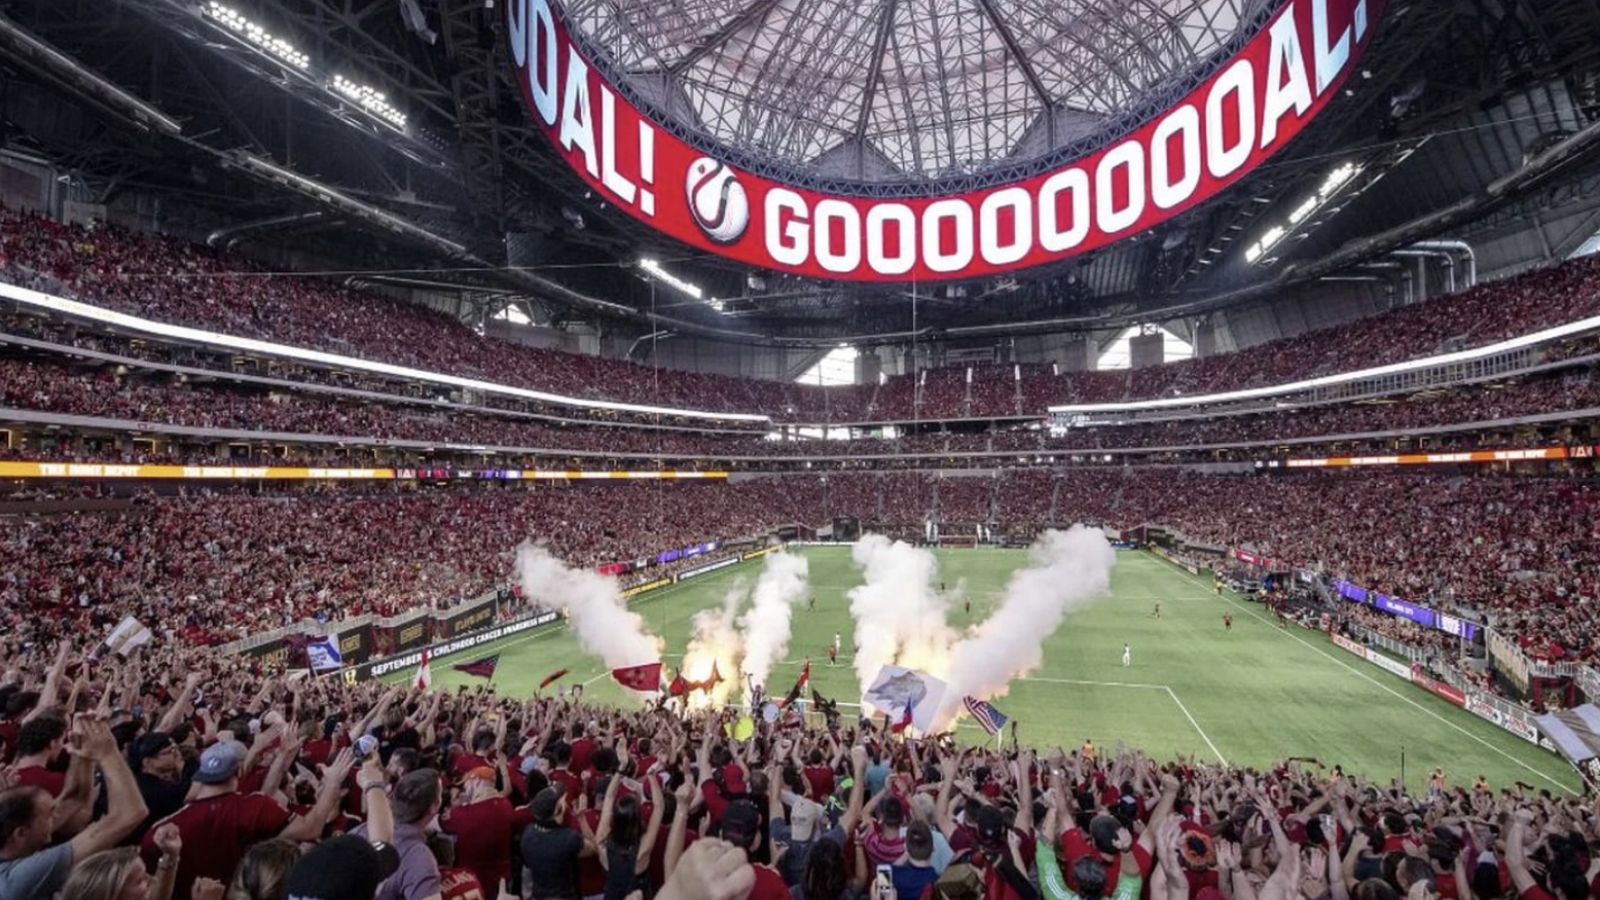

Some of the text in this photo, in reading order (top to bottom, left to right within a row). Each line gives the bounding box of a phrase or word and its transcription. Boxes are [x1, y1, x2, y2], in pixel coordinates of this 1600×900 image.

[371, 653, 422, 676] SEPTEMBER
[433, 636, 475, 657] CHILDHOOD
[476, 629, 502, 644] CANCER
